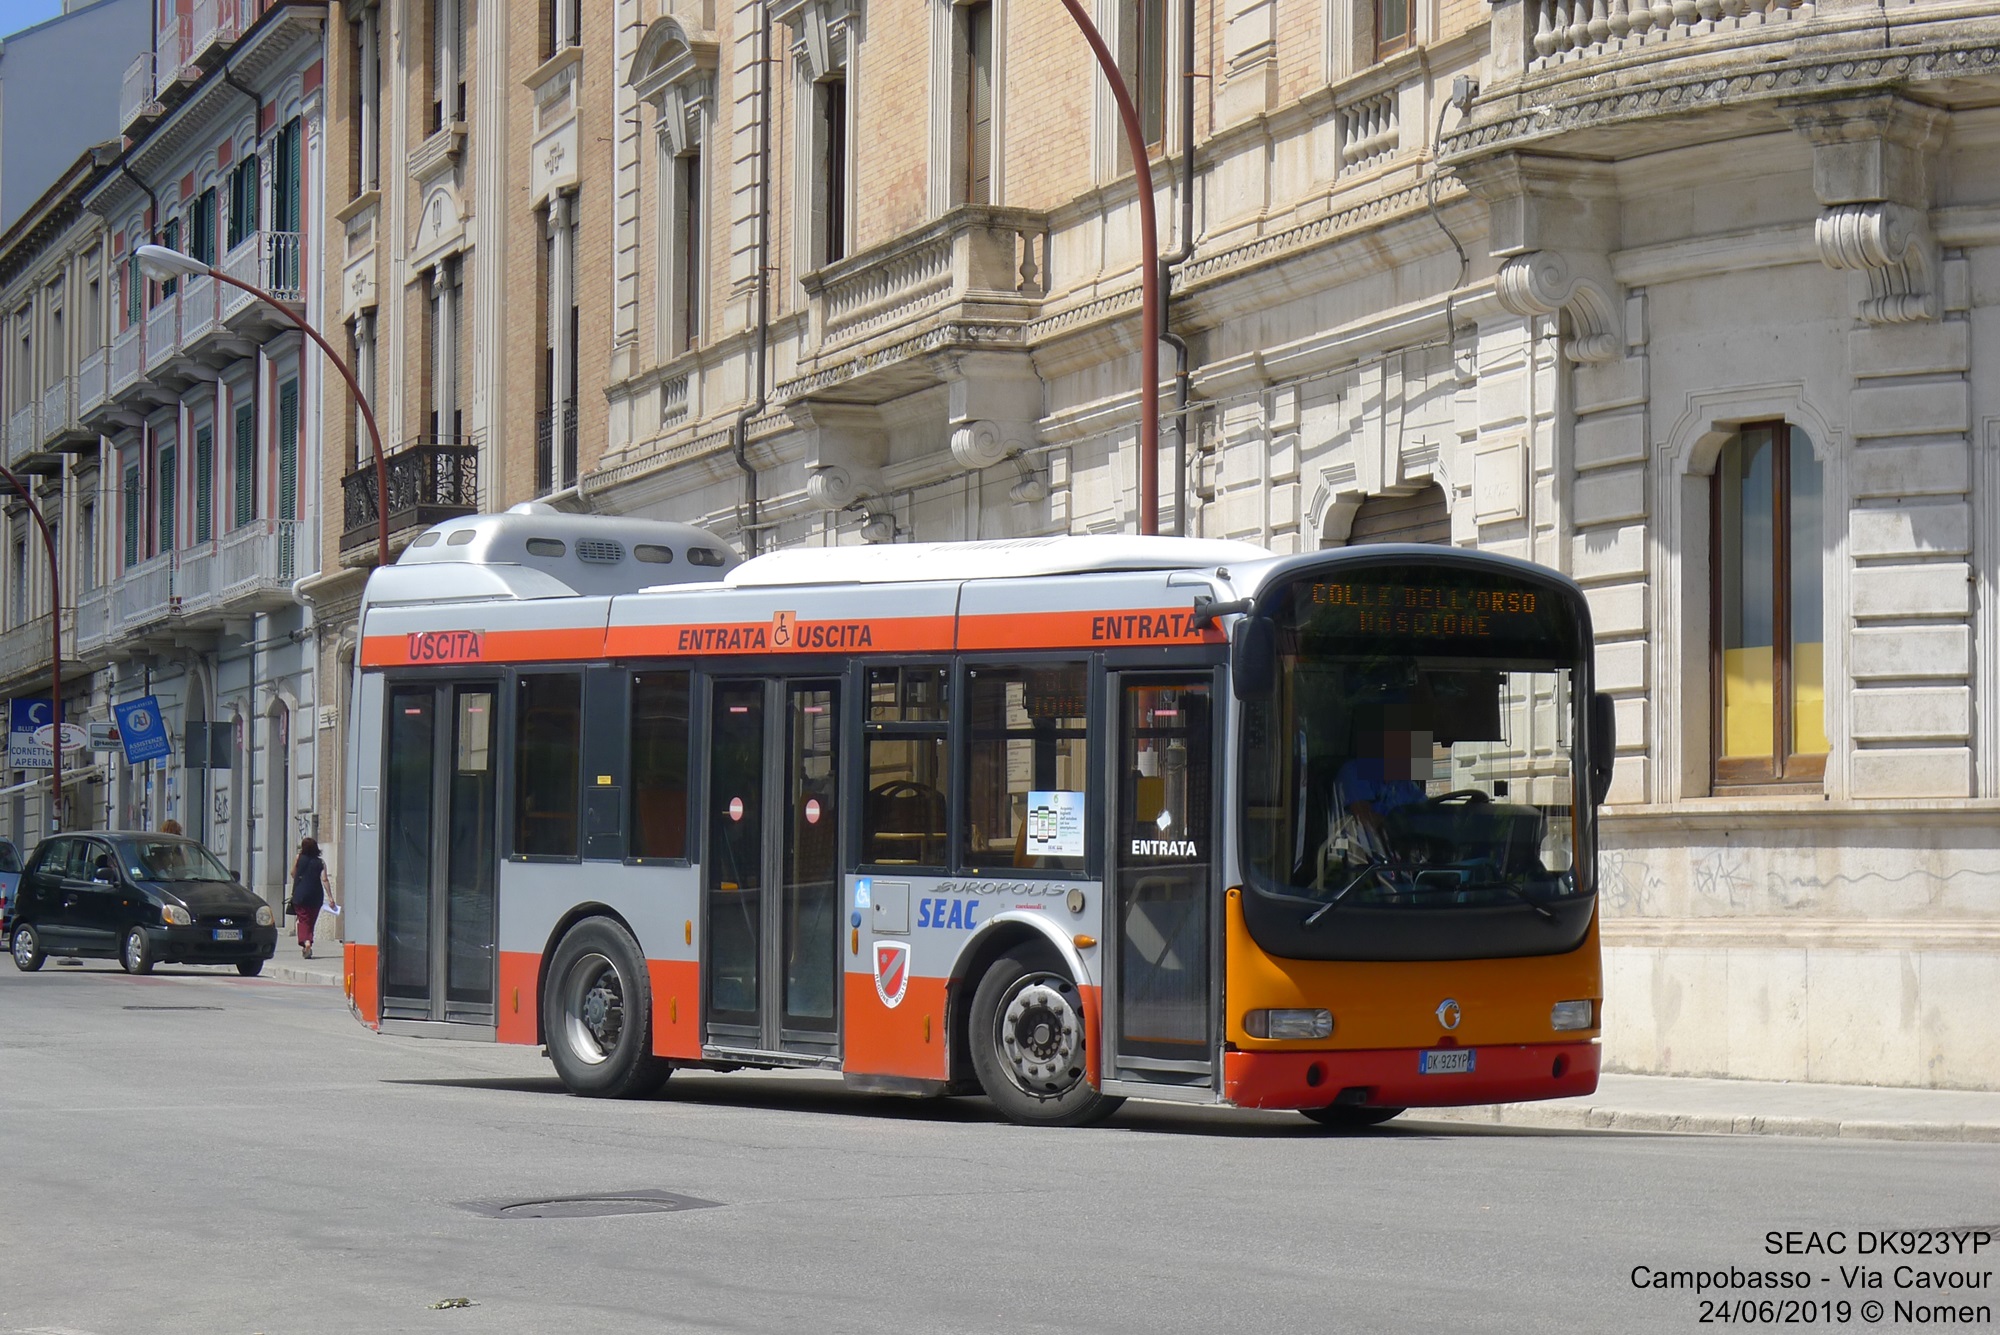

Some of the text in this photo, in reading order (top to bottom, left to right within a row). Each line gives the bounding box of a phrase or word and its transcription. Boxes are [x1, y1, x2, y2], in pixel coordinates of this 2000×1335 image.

[1312, 583, 1536, 613] COLLE DELL'ORSO
[678, 624, 872, 651] ENTRATA USCITA
[1092, 613, 1200, 640] ENTRATA
[410, 633, 480, 660] USCITA
[129, 736, 163, 750] ASSISTENZE
[15, 758, 53, 766] APERIBA
[1132, 839, 1197, 857] ENTRATA
[917, 898, 980, 930] SEAC
[875, 974, 889, 1004] REGIONE
[1427, 1054, 1468, 1069] DK 923YP
